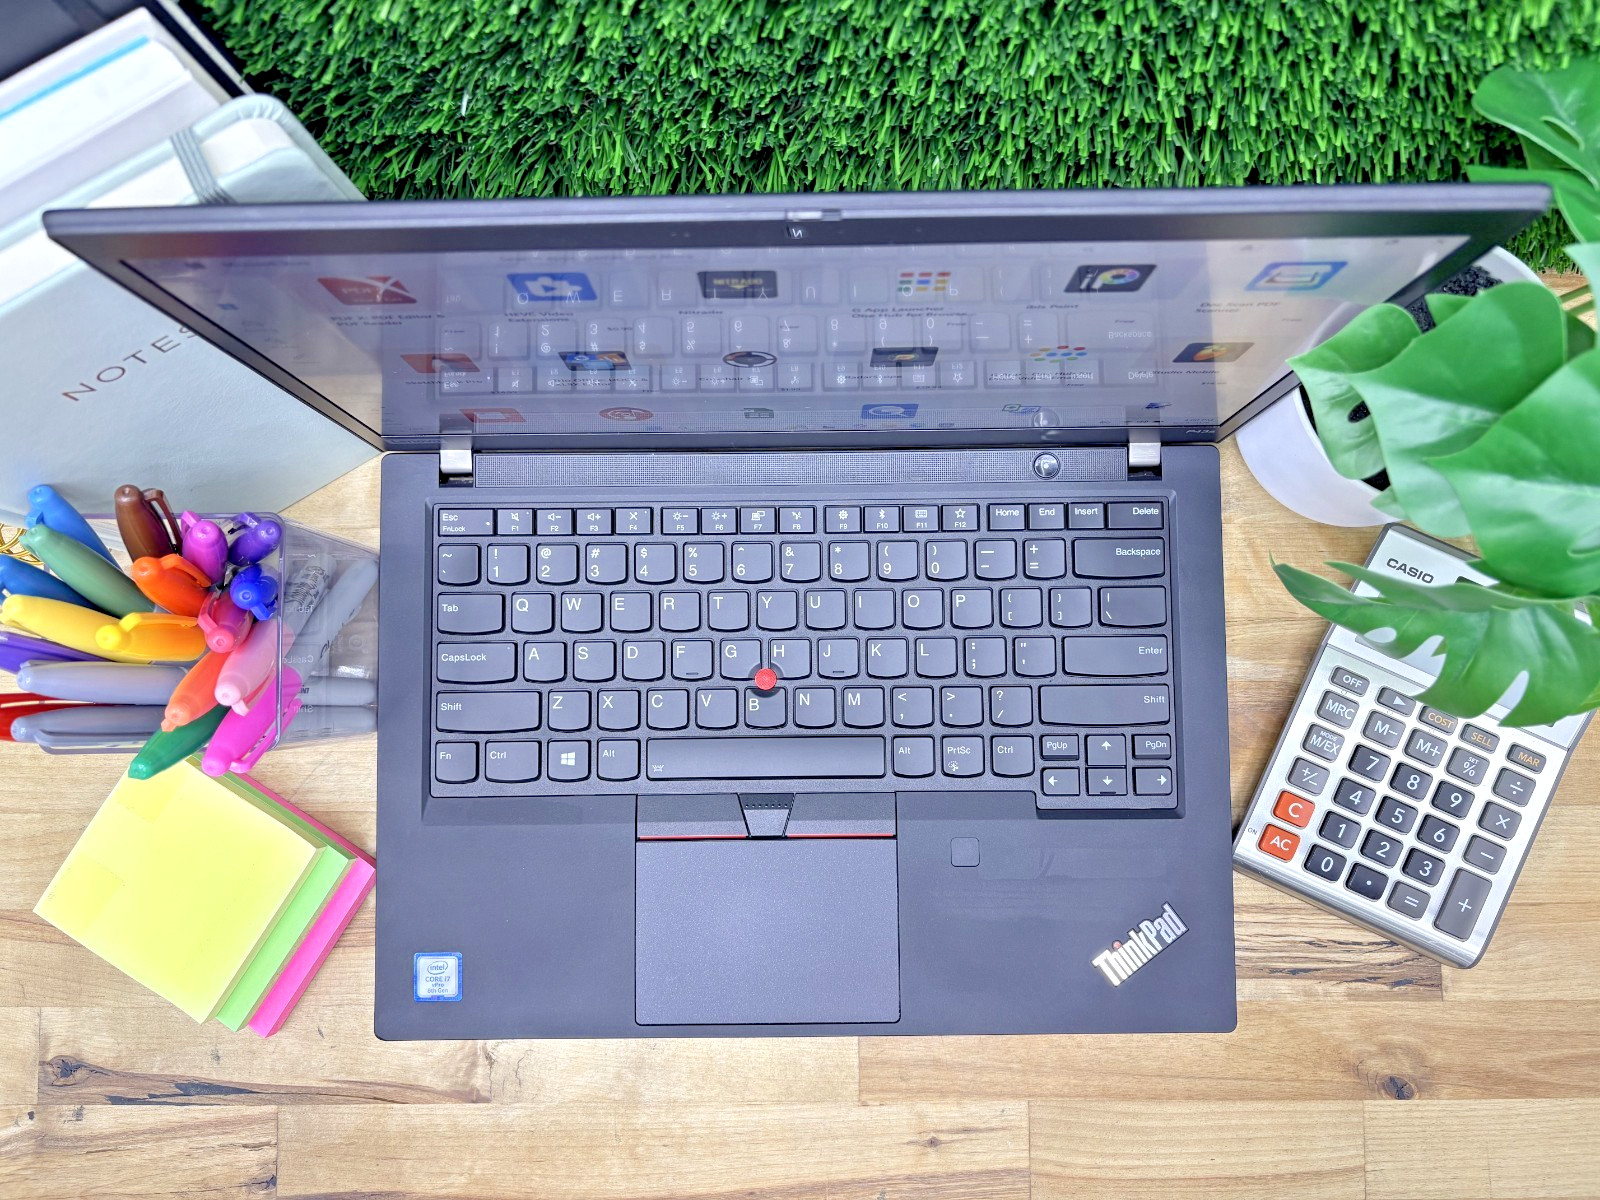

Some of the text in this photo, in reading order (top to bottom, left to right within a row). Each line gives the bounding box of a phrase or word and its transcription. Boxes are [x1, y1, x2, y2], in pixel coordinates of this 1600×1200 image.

[1133, 507, 1159, 515] Delete
[1116, 548, 1160, 558] Backspace
[493, 566, 499, 577] 1
[542, 565, 550, 577] 2
[591, 565, 599, 577] 3
[639, 565, 648, 578] 4
[689, 565, 697, 576] 5
[736, 564, 745, 577] 6
[786, 564, 793, 575] 7
[833, 563, 842, 576] 8
[884, 563, 891, 574] 9
[932, 562, 939, 573] 0
[1387, 558, 1434, 584] CASIO
[516, 599, 529, 612] Q
[566, 598, 581, 610] W
[615, 598, 624, 610] E
[664, 598, 674, 610] R
[713, 597, 723, 609] T
[762, 596, 772, 608] Y
[811, 596, 820, 608] U
[859, 596, 861, 608] I
[908, 595, 919, 608] O
[956, 595, 965, 607] P
[442, 604, 458, 612] Tab
[529, 648, 539, 660] A
[578, 647, 588, 660] S
[628, 646, 638, 659] D
[677, 646, 685, 658] F
[725, 645, 736, 658] G
[774, 645, 784, 657] H
[823, 645, 830, 657] J
[872, 644, 881, 656] K
[921, 644, 929, 656] L
[442, 653, 486, 662] CapsLock
[1343, 674, 1363, 688] OFF
[553, 696, 563, 709] Z
[603, 696, 613, 708] X
[652, 695, 663, 707] C
[701, 694, 711, 707] V
[749, 698, 759, 710] B
[800, 693, 809, 705] N
[848, 693, 860, 705] M
[1144, 695, 1164, 703] Shift
[1326, 699, 1355, 719] MRC
[1428, 712, 1454, 729] COST
[1320, 730, 1337, 741] MODE
[1471, 731, 1491, 748] SELL
[948, 746, 970, 754] PrtSc
[998, 746, 1013, 754] Ctrl
[1047, 741, 1067, 750] PgUp
[1146, 741, 1166, 749] PgDn
[1311, 735, 1341, 756] M/EX
[1416, 738, 1440, 756] M+
[490, 751, 506, 759] Ctrl
[1468, 756, 1478, 764] SET
[1519, 751, 1540, 767] MAR
[1366, 756, 1377, 771] 7
[1407, 776, 1418, 790] 8
[1350, 790, 1361, 805] 4
[1450, 793, 1462, 808] 9
[1288, 803, 1301, 818] C
[1391, 809, 1403, 824] 5
[1338, 823, 1346, 838] 1
[1434, 828, 1445, 842] 6
[1270, 835, 1291, 851] AC
[1377, 841, 1388, 856] 2
[1321, 857, 1333, 871] 0
[1420, 862, 1432, 876] 3
[1091, 902, 1188, 986] ThinkPad
